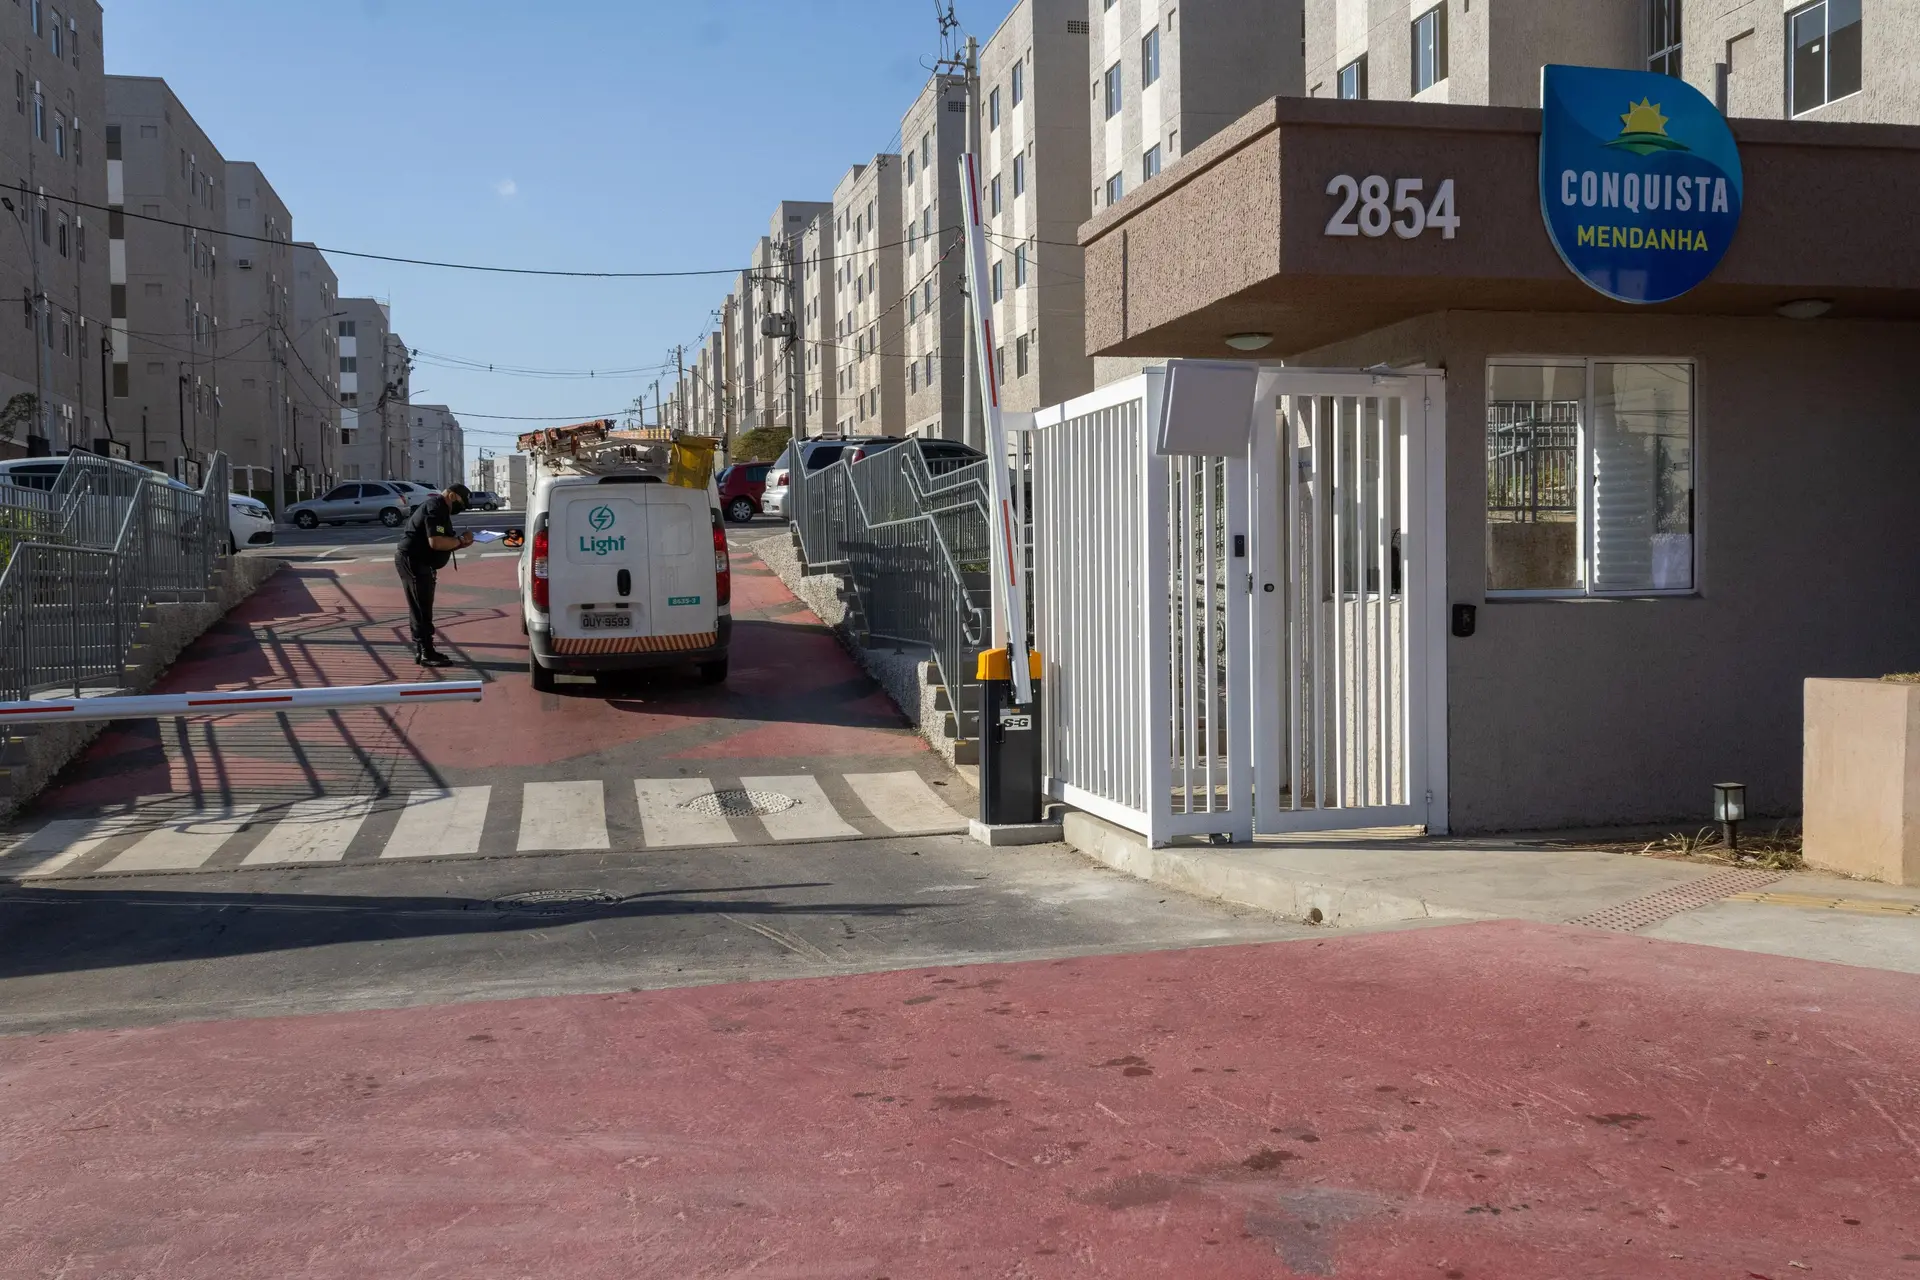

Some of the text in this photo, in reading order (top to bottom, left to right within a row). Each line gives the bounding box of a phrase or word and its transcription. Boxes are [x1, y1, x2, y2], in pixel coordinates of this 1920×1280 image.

[1324, 174, 1460, 240] 2854
[1561, 169, 1729, 214] CONQUISTA
[1577, 225, 1709, 252] MENDANHA
[580, 535, 626, 556] Light
